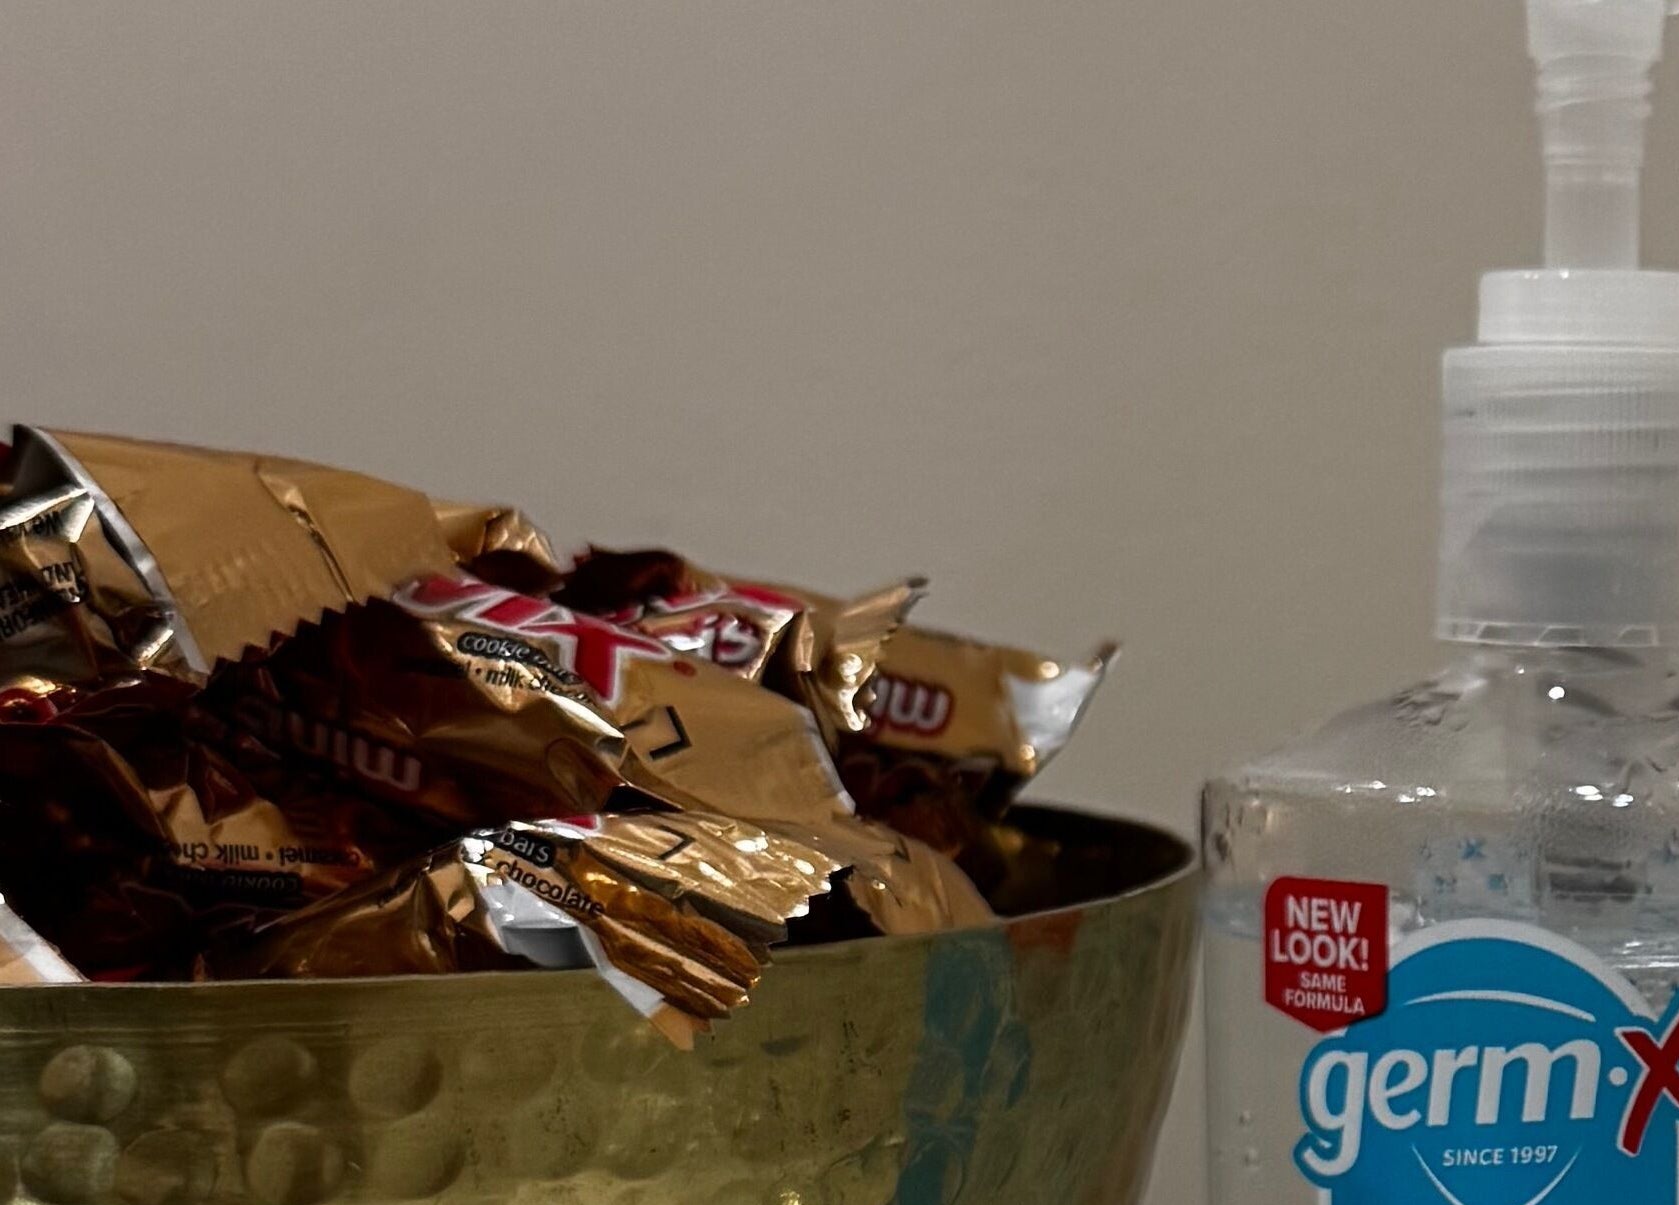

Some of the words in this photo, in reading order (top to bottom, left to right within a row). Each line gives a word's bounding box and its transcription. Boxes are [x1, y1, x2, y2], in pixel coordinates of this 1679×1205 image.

[462, 634, 530, 658] cookie
[214, 843, 258, 864] milk
[500, 827, 549, 863] bars
[1286, 895, 1362, 934] NEW
[1271, 929, 1369, 971] LOOK!
[1299, 971, 1347, 993] SAME
[1283, 988, 1365, 1016] FORMULA
[1442, 1147, 1504, 1168] SINCE
[1511, 1144, 1559, 1165] 1997
